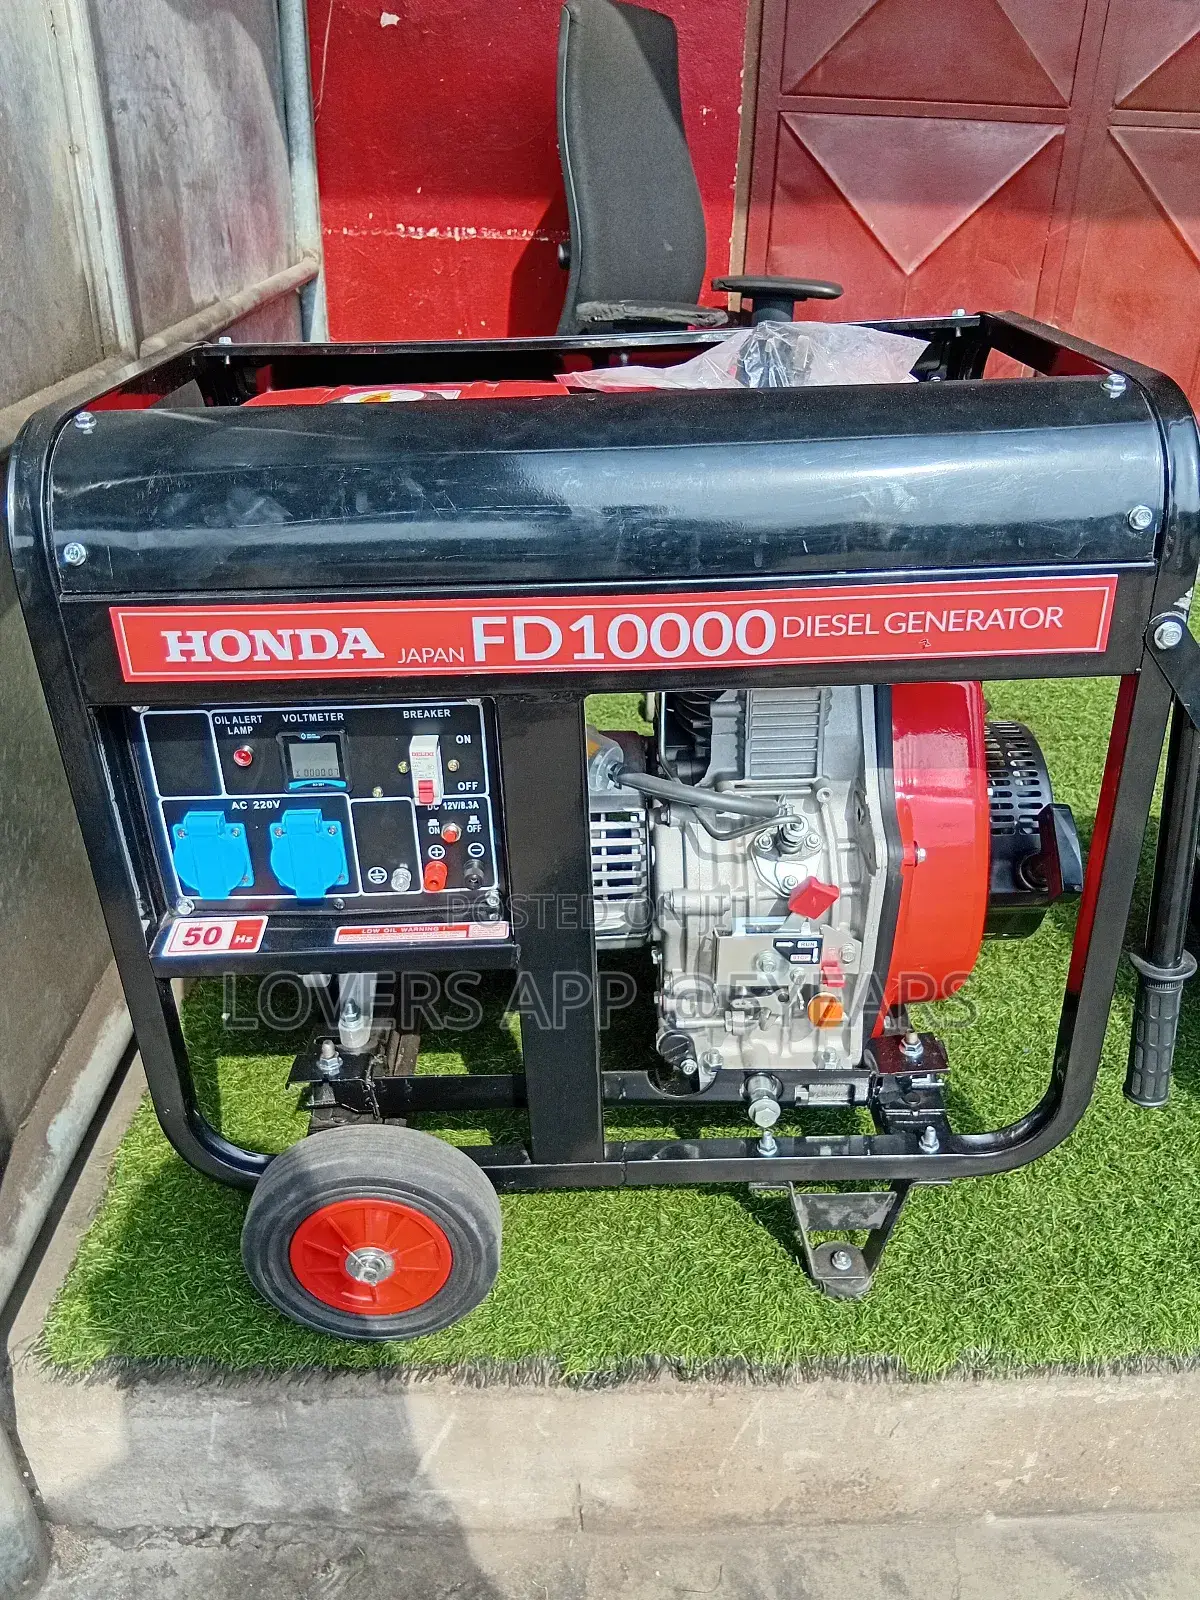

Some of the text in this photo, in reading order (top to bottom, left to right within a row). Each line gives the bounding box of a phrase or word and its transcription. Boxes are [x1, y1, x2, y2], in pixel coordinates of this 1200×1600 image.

[160, 605, 1064, 665] HONDA JAPAN FD10000 DIESEL GENERATOR
[281, 712, 345, 723] VOLTMETER
[402, 708, 452, 719] BREAKER
[214, 714, 263, 725] OIL ALERT
[227, 725, 254, 735] LAMP
[455, 734, 472, 744] ON
[457, 781, 479, 791] OFF
[231, 799, 281, 810] AC 220V
[442, 800, 480, 811] 12V/8.3A
[428, 826, 441, 835] ON
[466, 824, 482, 833] OFF
[400, 925, 440, 933] WARNING
[182, 926, 254, 946] 50 Hz
